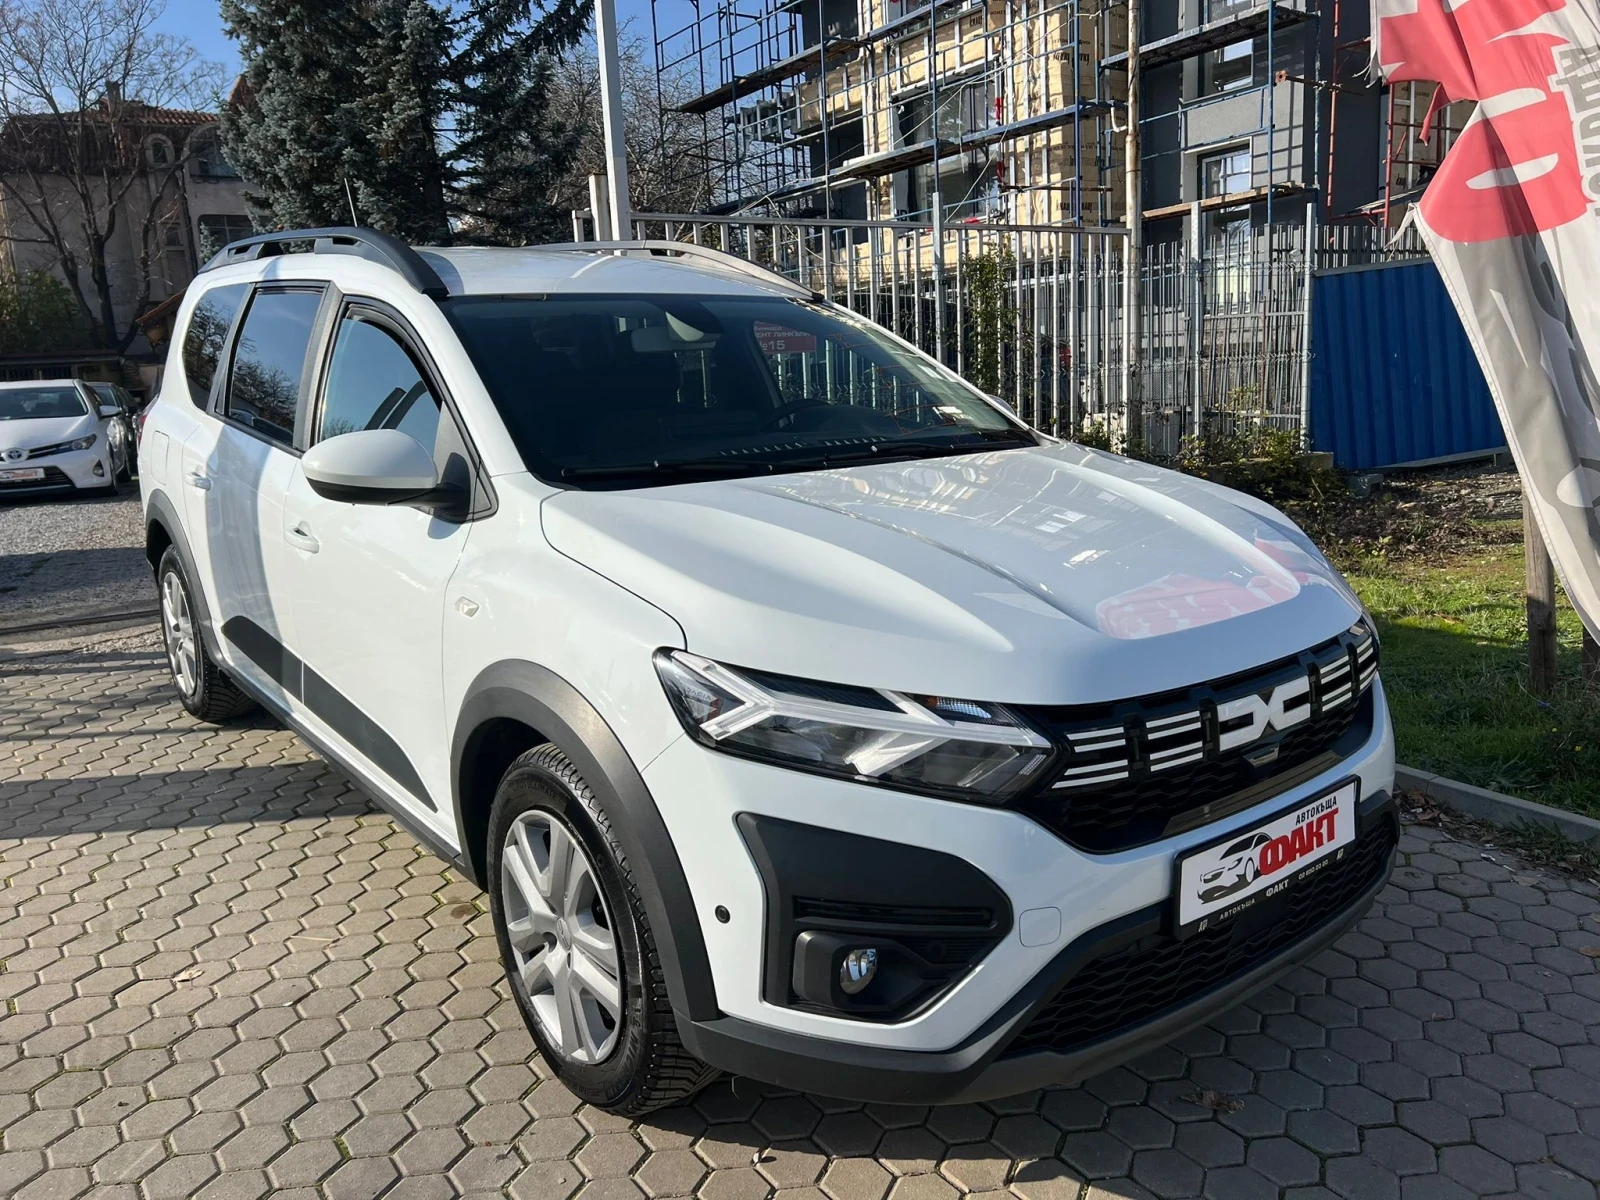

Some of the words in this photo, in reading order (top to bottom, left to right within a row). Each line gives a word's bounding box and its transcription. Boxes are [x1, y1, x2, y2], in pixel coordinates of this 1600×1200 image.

[1295, 796, 1337, 826] АВТОКЪЩА
[1258, 807, 1339, 876] ФАКТ
[1265, 879, 1289, 897] ФАКТ
